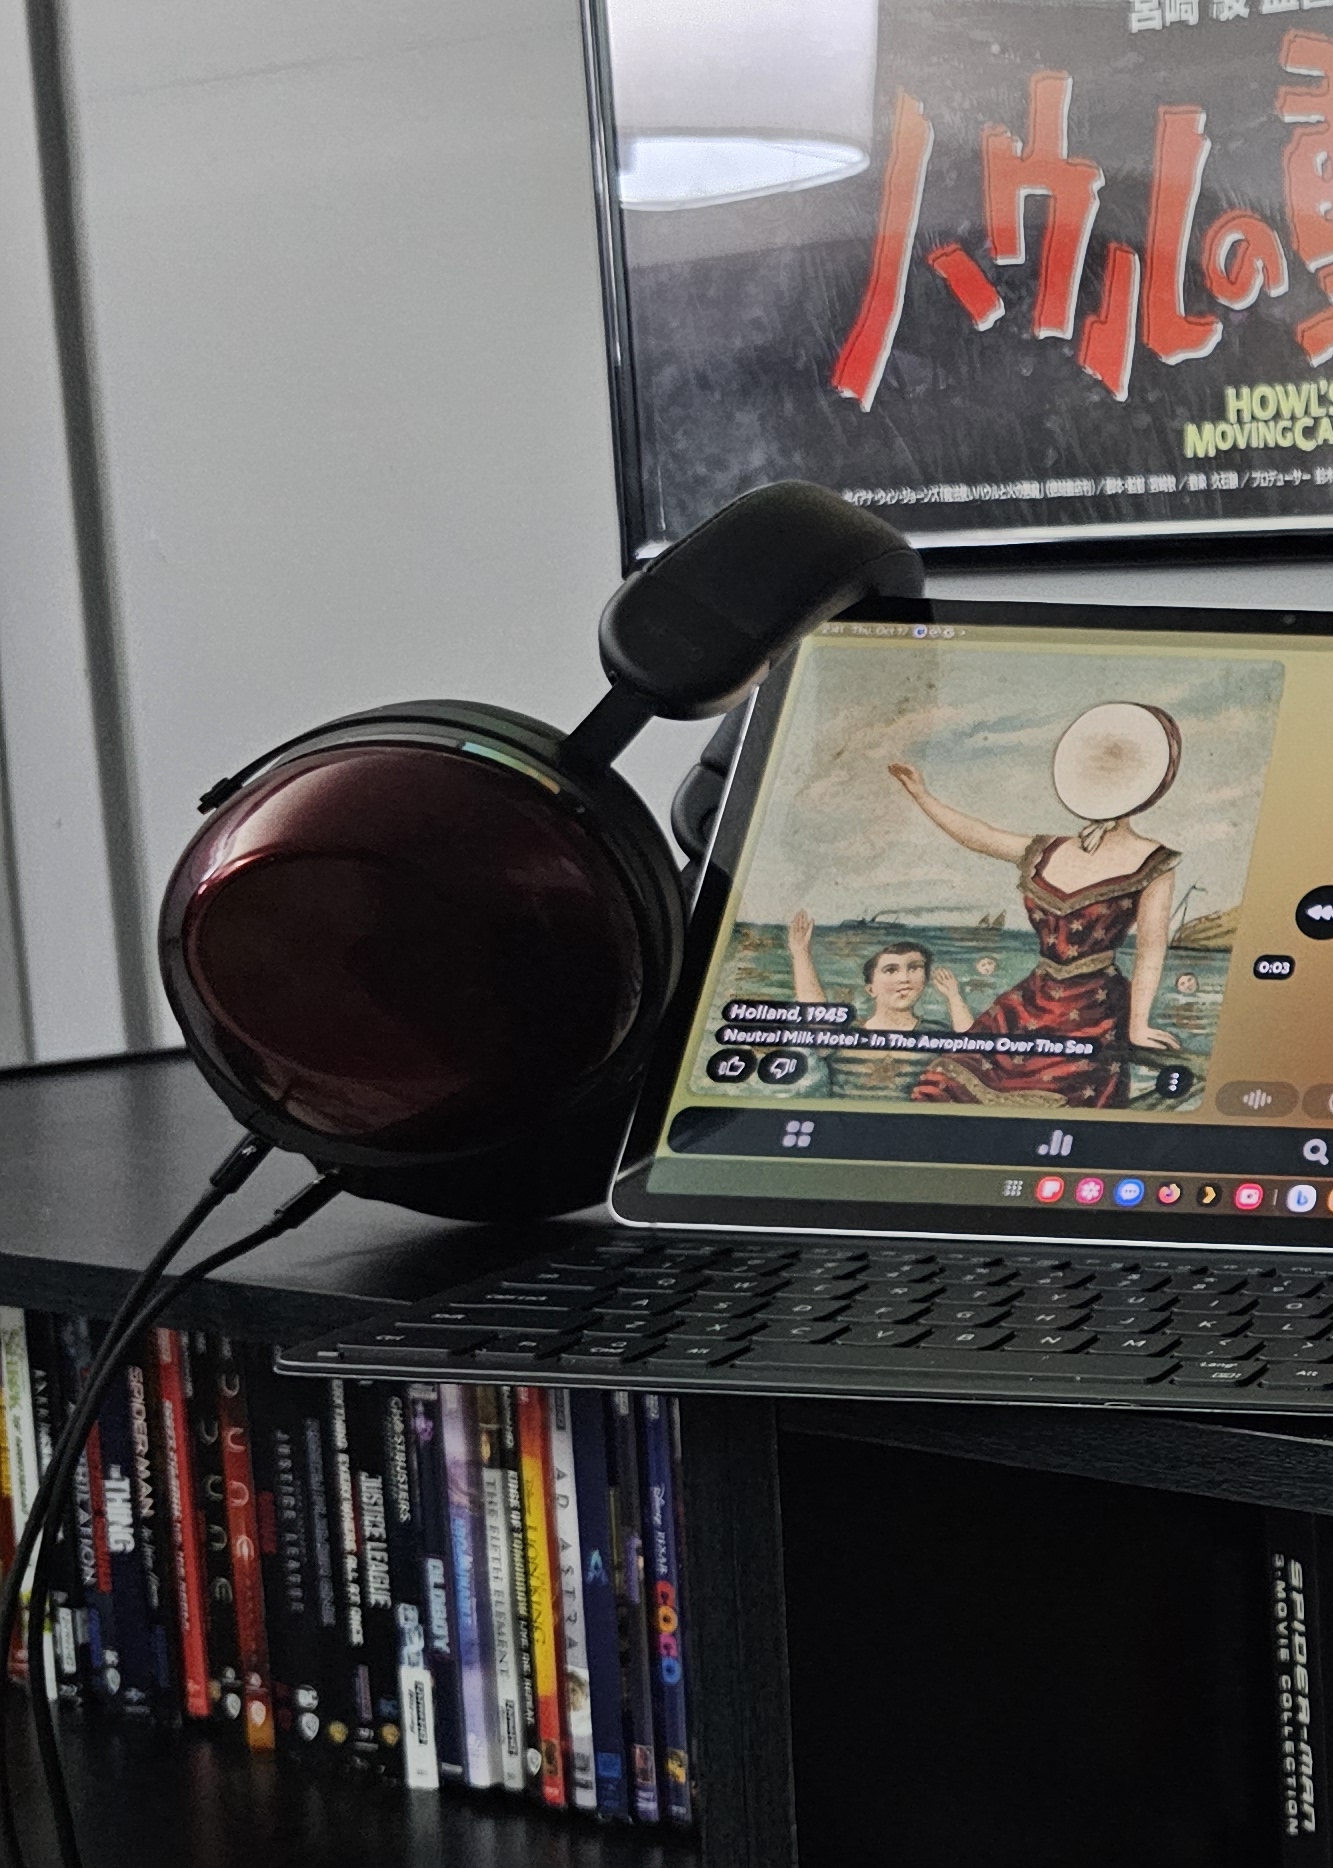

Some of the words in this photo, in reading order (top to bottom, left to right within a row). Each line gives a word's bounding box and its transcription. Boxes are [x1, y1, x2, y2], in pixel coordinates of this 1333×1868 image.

[1259, 961, 1291, 975] 0:03
[723, 1028, 781, 1043] Neutral
[781, 1030, 814, 1044] Milk
[816, 1032, 860, 1046] Hotel
[869, 1034, 886, 1047] In
[889, 1033, 917, 1048] The
[917, 1034, 995, 1052] Aeroplane
[996, 1037, 1034, 1052] Over
[1035, 1038, 1064, 1053] The
[1065, 1039, 1094, 1055] Sea
[730, 1004, 802, 1023] Holland,
[806, 1006, 849, 1023] 1945
[103, 1475, 136, 1554] THING
[359, 1470, 388, 1542] JUSTICE
[366, 1542, 393, 1610] LEAGUE
[558, 1536, 580, 1650] ASTRA
[1273, 1553, 1291, 1664] 3-MOVIE
[654, 1579, 682, 1686] COCO
[1288, 1558, 1316, 1834] SPIDER-MAN
[1278, 1674, 1299, 1837] COLLECTION
